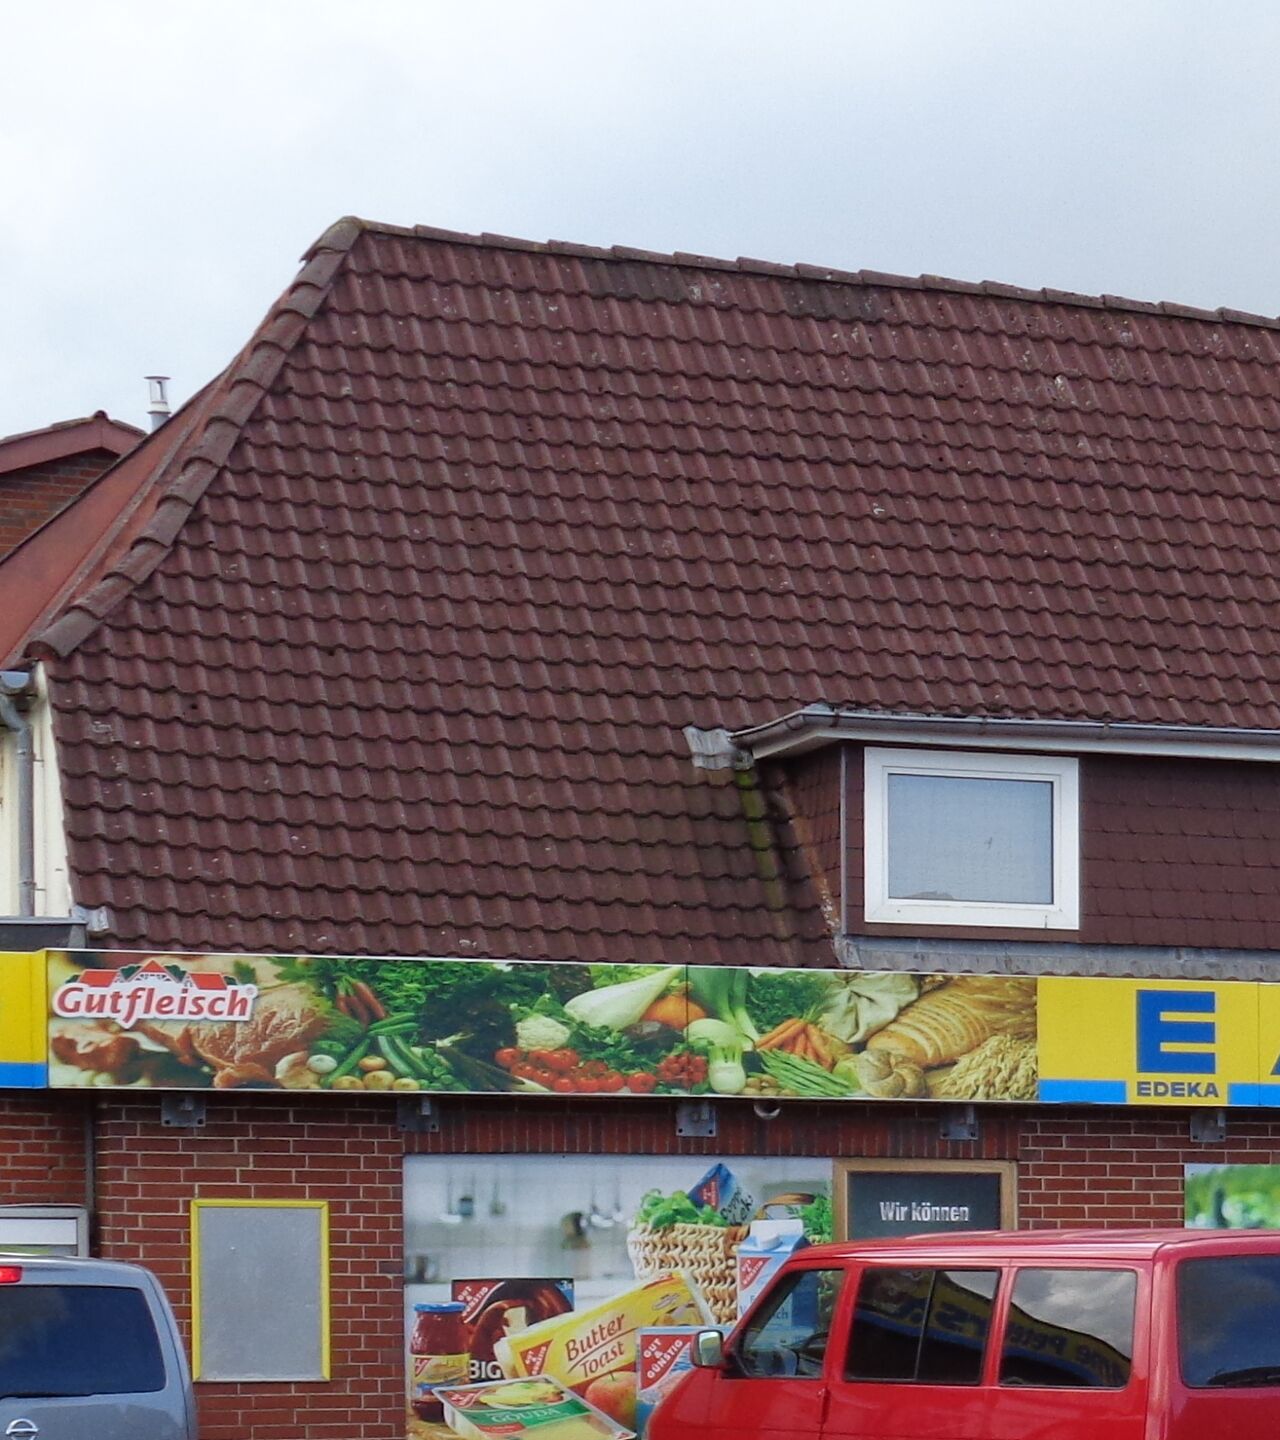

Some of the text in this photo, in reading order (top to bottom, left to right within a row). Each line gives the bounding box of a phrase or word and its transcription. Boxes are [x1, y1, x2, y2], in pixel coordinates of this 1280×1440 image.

[57, 986, 249, 1024] Gutfleisch
[1136, 990, 1216, 1075] E
[1136, 1081, 1219, 1098] EDEKA
[879, 1201, 969, 1221] Wir können
[565, 1313, 625, 1361] Butter
[643, 1338, 662, 1358] GUT
[468, 1360, 502, 1379] BIG
[580, 1341, 625, 1378] Toast
[491, 1408, 562, 1424] GOUDA
